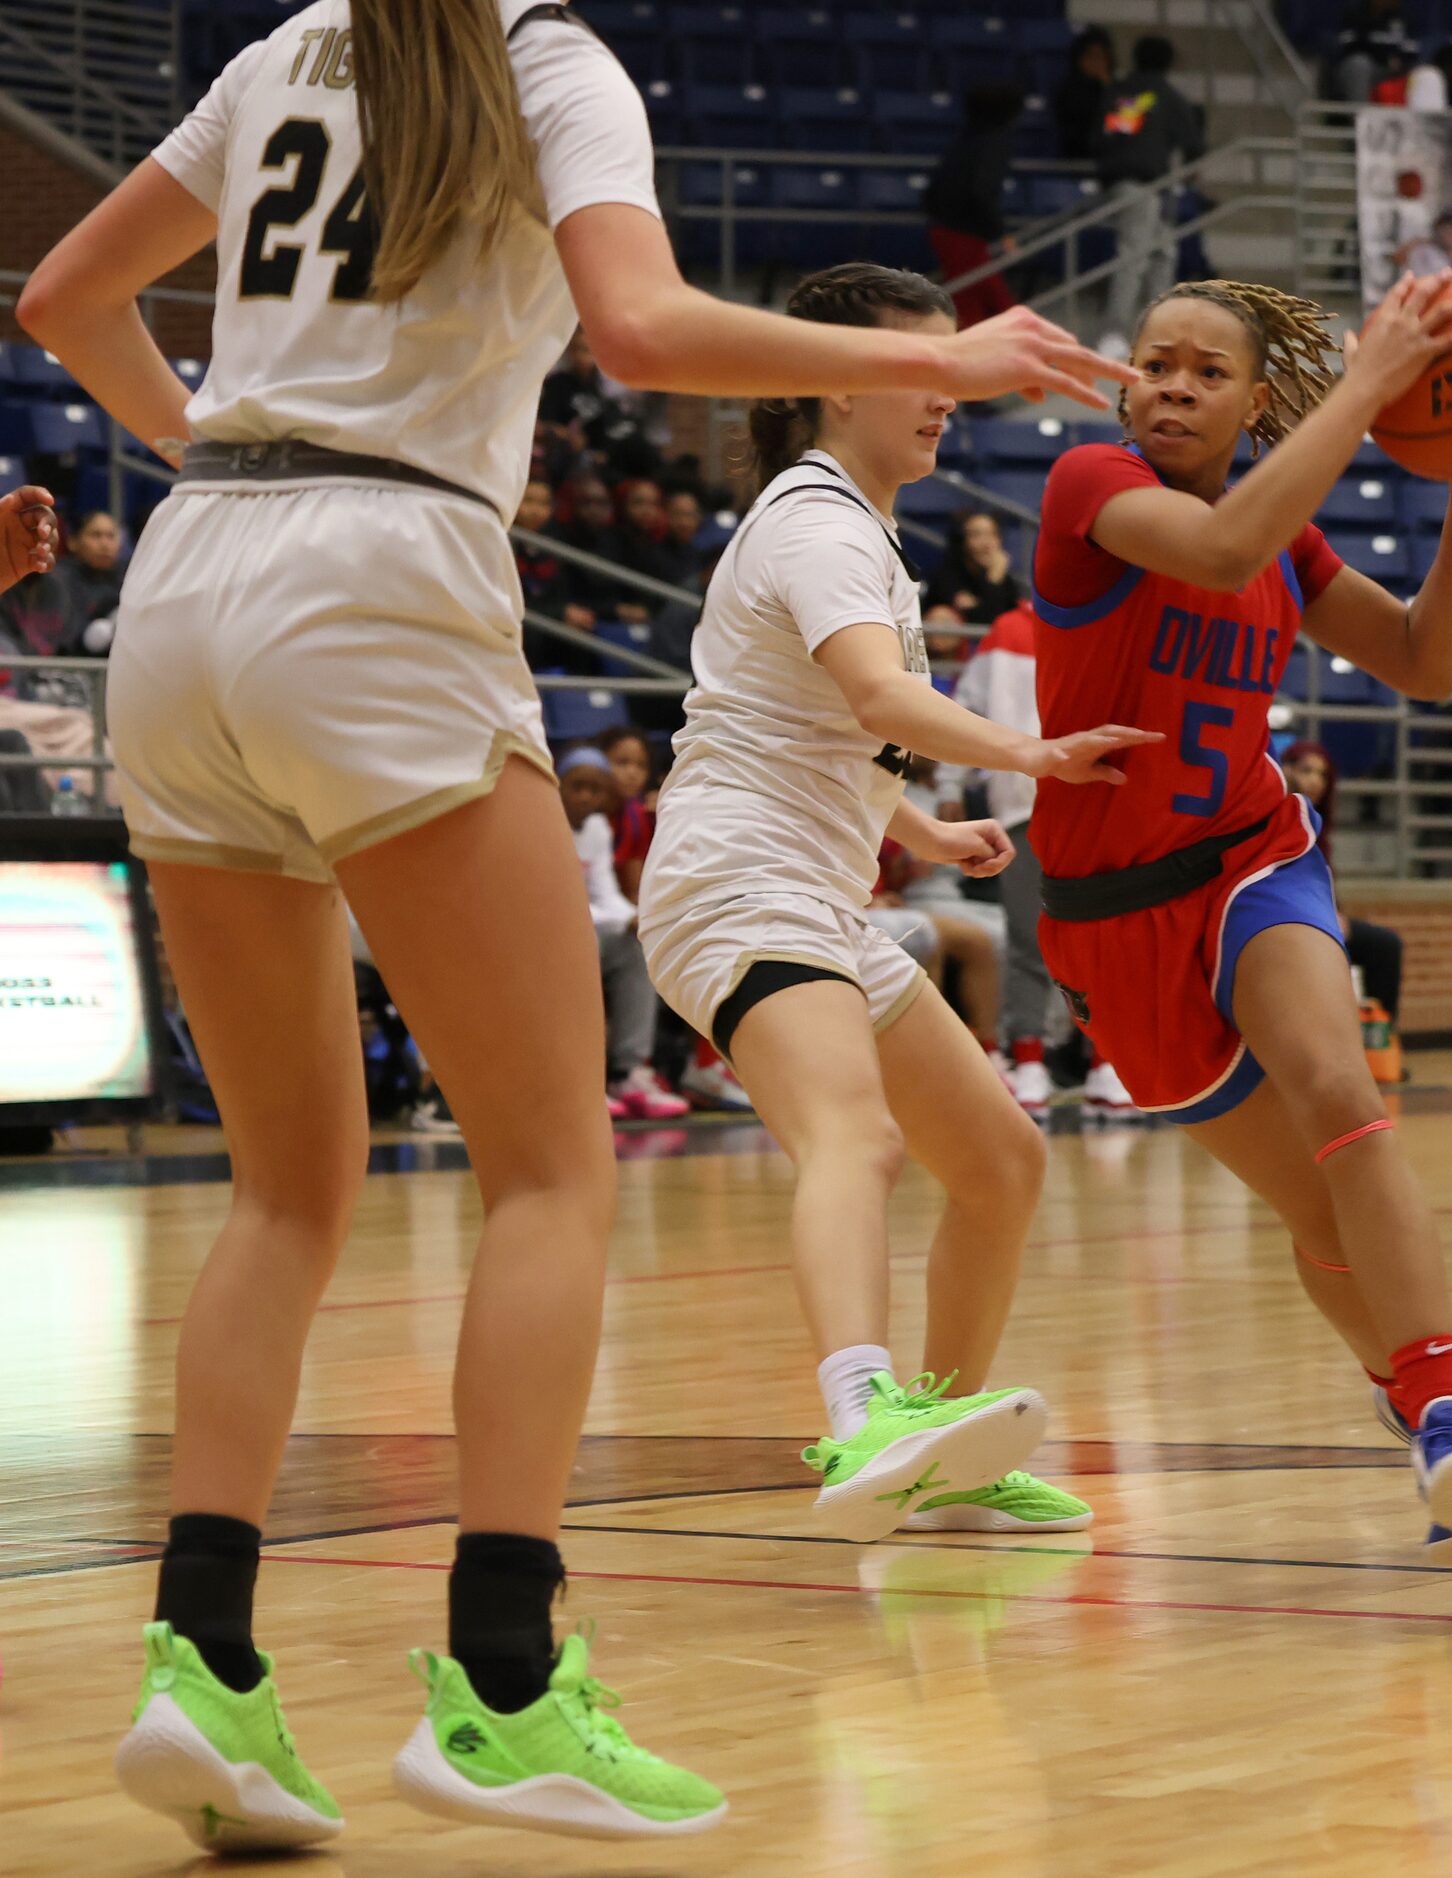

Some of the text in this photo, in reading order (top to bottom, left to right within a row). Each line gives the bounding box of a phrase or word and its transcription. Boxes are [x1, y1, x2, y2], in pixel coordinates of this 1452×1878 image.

[287, 27, 355, 90] TIG
[237, 115, 379, 304] 24
[1171, 700, 1235, 818] 5
